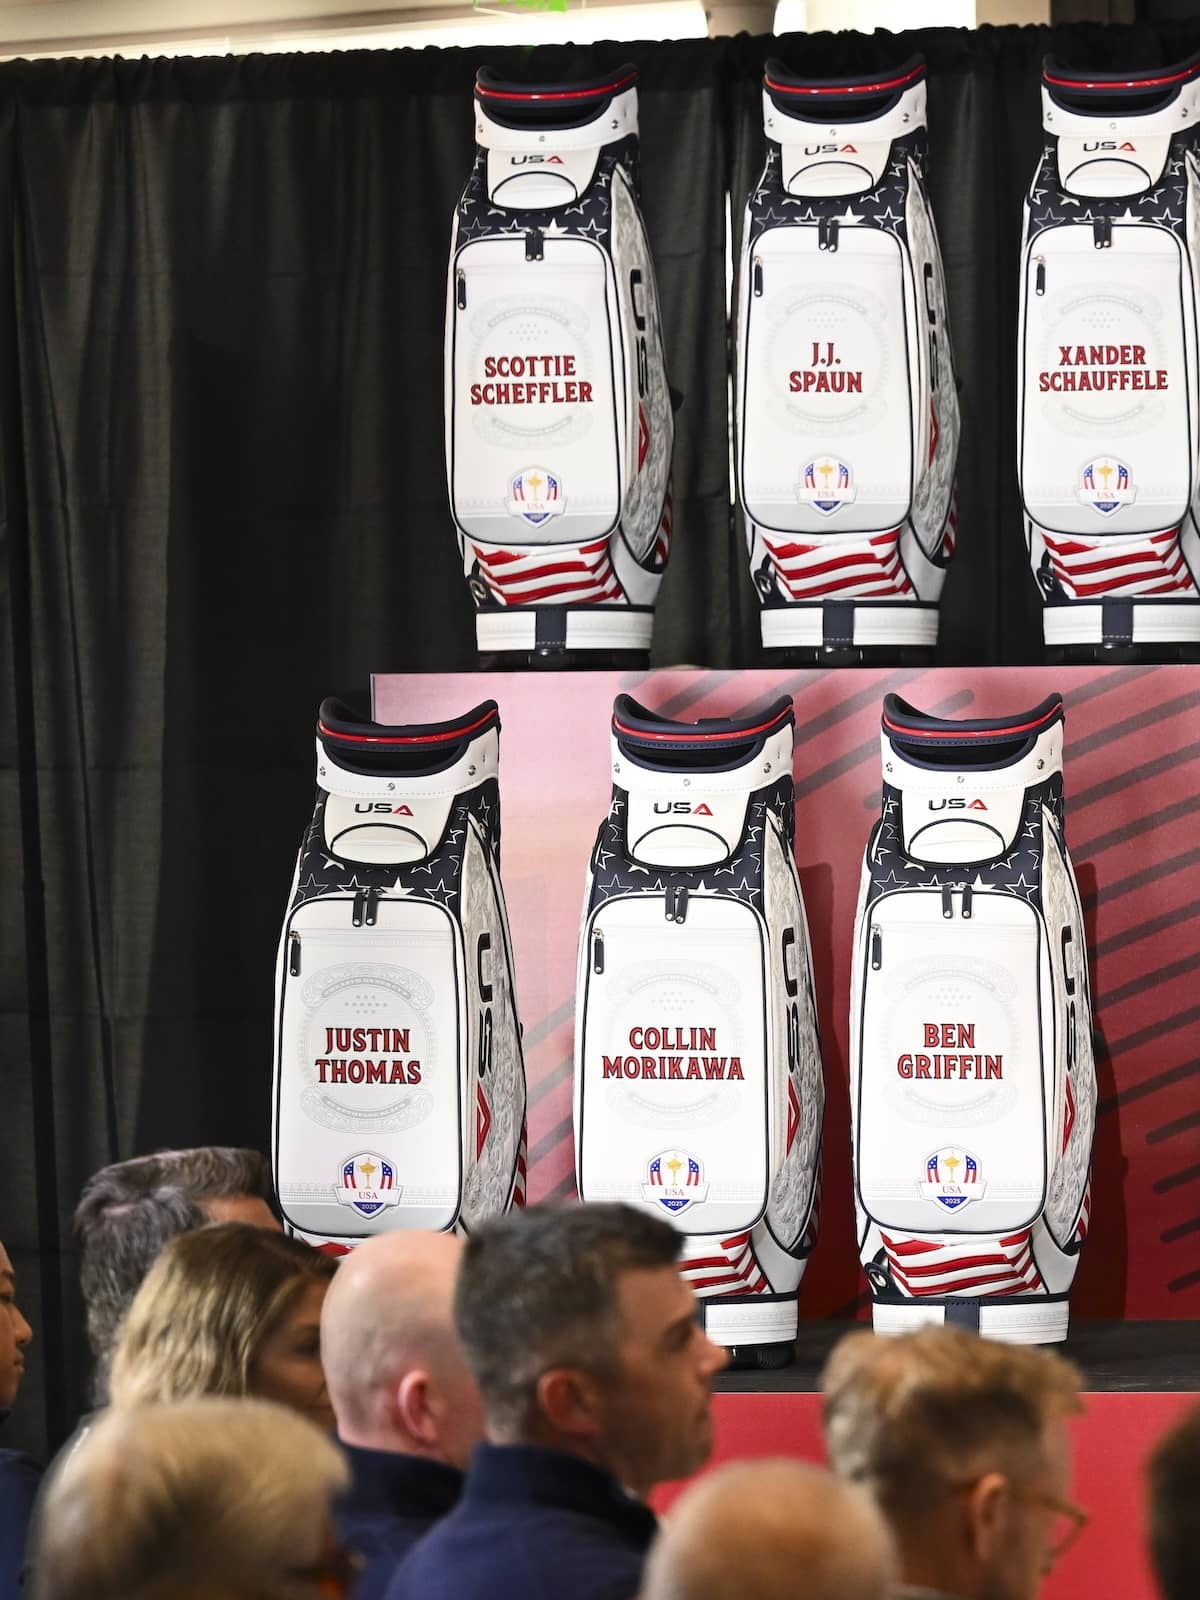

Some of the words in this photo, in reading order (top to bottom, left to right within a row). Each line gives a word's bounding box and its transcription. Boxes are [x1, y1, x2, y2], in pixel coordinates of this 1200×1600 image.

[805, 145, 856, 155] USA
[1084, 142, 1135, 151] USA
[511, 155, 562, 165] USA
[812, 343, 840, 367] J.J.
[1059, 345, 1145, 365] XANDER
[485, 356, 576, 377] SCOTTIE
[790, 371, 862, 392] SPAUN
[1040, 370, 1168, 392] SCHAUFFELE
[471, 382, 592, 405] SCHEFFLER
[355, 803, 413, 816] USA
[654, 802, 712, 816] USA
[929, 799, 987, 810] USA
[325, 1028, 410, 1054] JUSTIN
[629, 1027, 716, 1050] COLLIN
[924, 1024, 975, 1048] BEN
[315, 1059, 421, 1084] THOMAS
[602, 1056, 744, 1080] MORIKAWA
[898, 1054, 1002, 1079] GRIFFIN
[665, 1188, 684, 1196] USA
